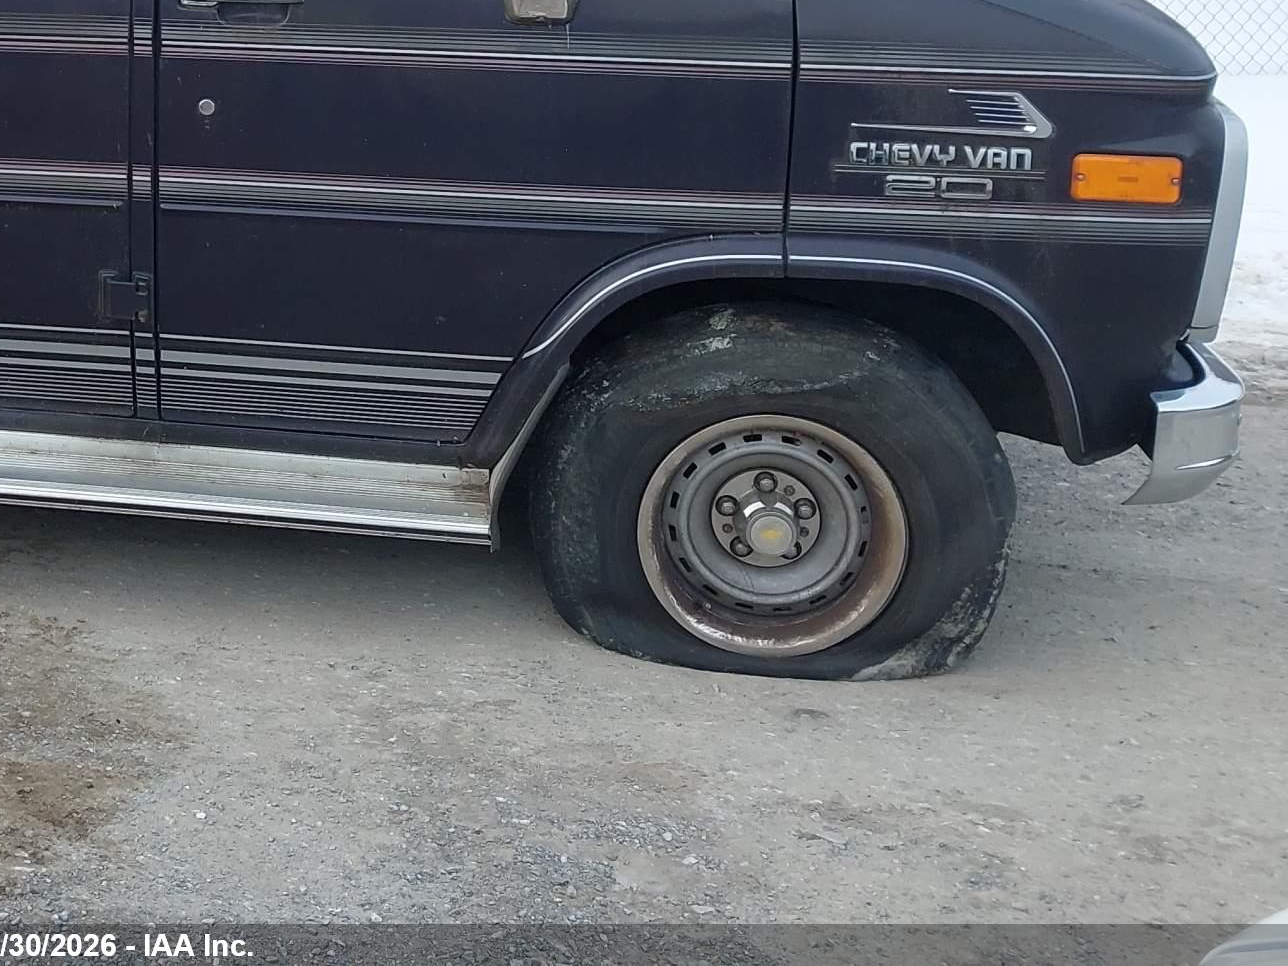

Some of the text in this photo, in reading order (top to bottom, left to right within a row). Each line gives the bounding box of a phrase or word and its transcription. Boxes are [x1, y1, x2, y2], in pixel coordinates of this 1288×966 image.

[849, 141, 1033, 171] CHEVY VAN
[885, 174, 994, 200] 20
